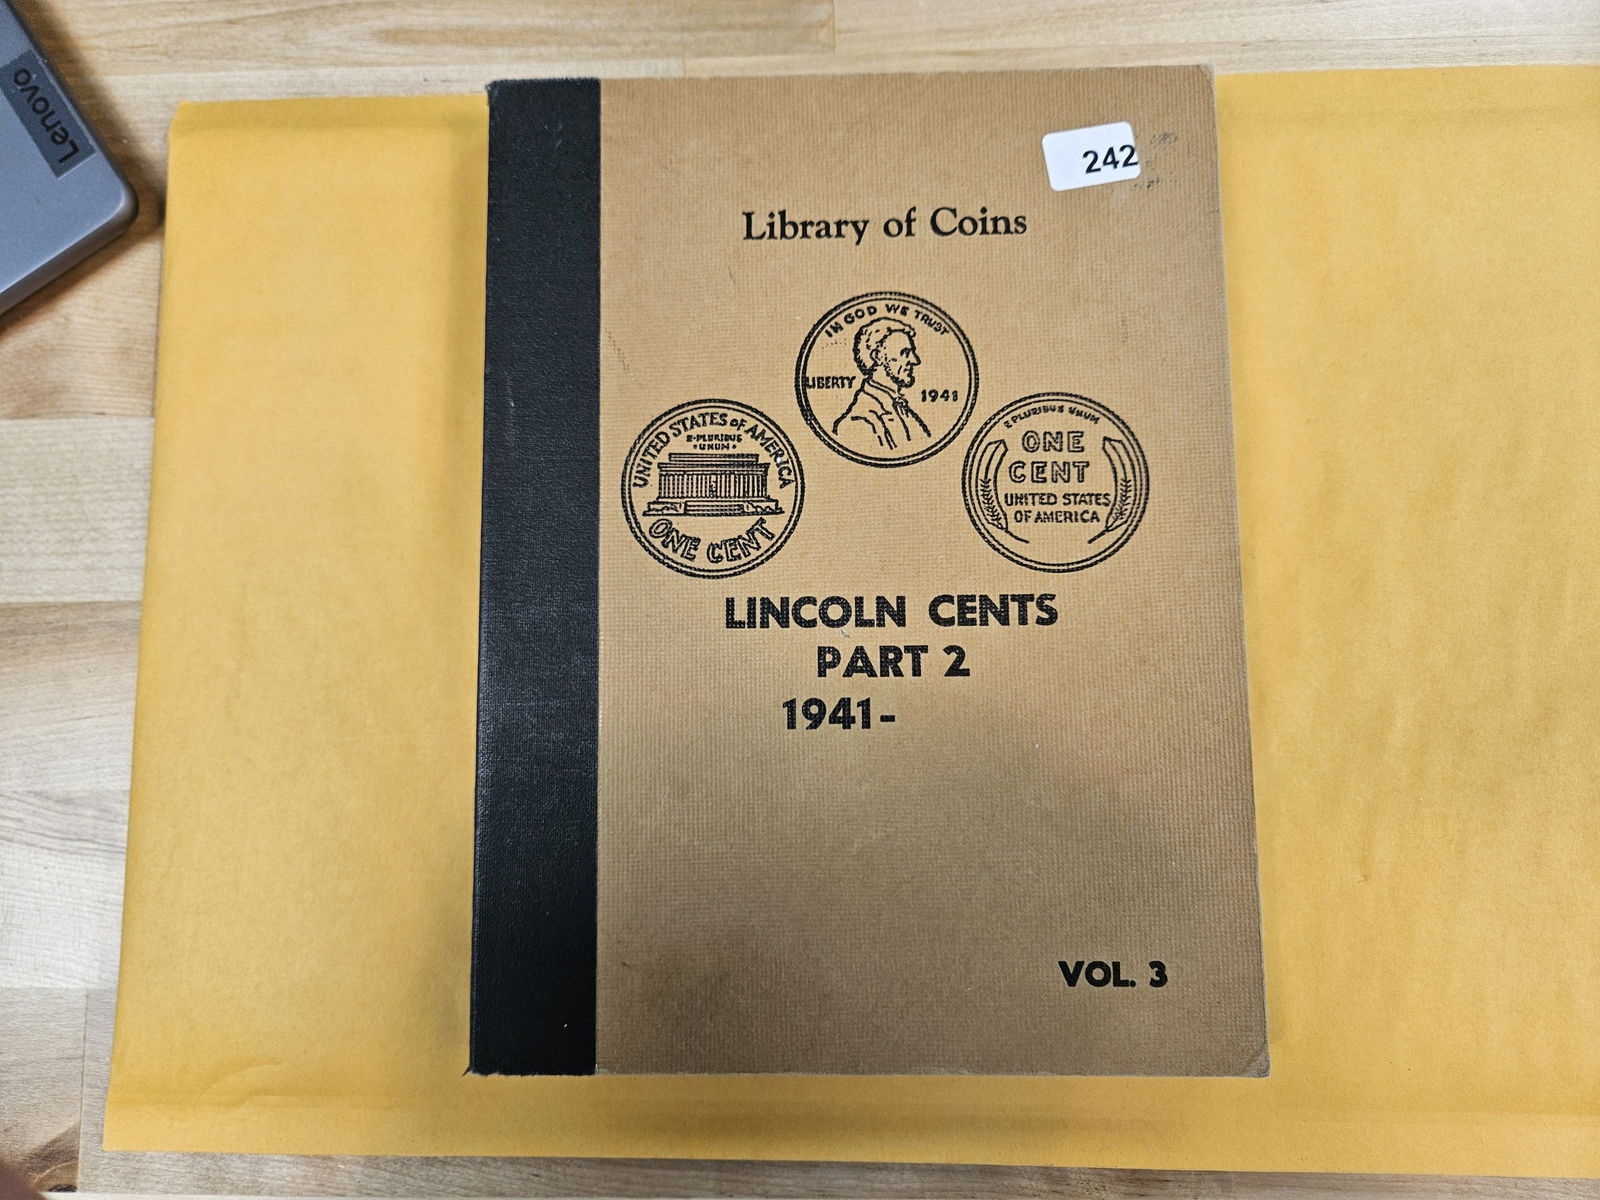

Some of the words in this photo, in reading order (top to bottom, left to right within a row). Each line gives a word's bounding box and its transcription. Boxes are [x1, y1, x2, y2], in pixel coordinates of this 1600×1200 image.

[14, 69, 79, 164] Lenovo
[1082, 144, 1139, 173] 242
[742, 211, 869, 245] Library
[883, 207, 916, 237] of
[930, 207, 1027, 236] Coins
[824, 322, 843, 337] IN
[844, 306, 877, 324] GOD
[885, 304, 909, 316] WE
[914, 310, 949, 336] TRUST
[805, 376, 856, 389] LIBERTY
[921, 389, 958, 402] 1941
[1004, 421, 1012, 429] E
[1011, 405, 1064, 423] PLURIBUS
[633, 431, 670, 488] UNITED
[669, 412, 728, 437] STATES
[744, 424, 796, 489] AMERICA
[1022, 431, 1085, 453] ONE
[1009, 460, 1089, 483] CENT
[1004, 493, 1057, 506] UNITED
[1062, 493, 1110, 507] STATES
[1014, 510, 1032, 522] OF
[1034, 510, 1100, 522] AMERICA
[649, 518, 701, 562] ONE
[706, 517, 775, 564] CENT
[726, 596, 906, 629] LINCOLN
[928, 594, 1058, 628] CENTS
[817, 645, 929, 678] PART
[944, 645, 970, 677] 2
[782, 698, 895, 730] 1941-
[1058, 961, 1136, 987] VOL.
[1149, 961, 1168, 987] 3
